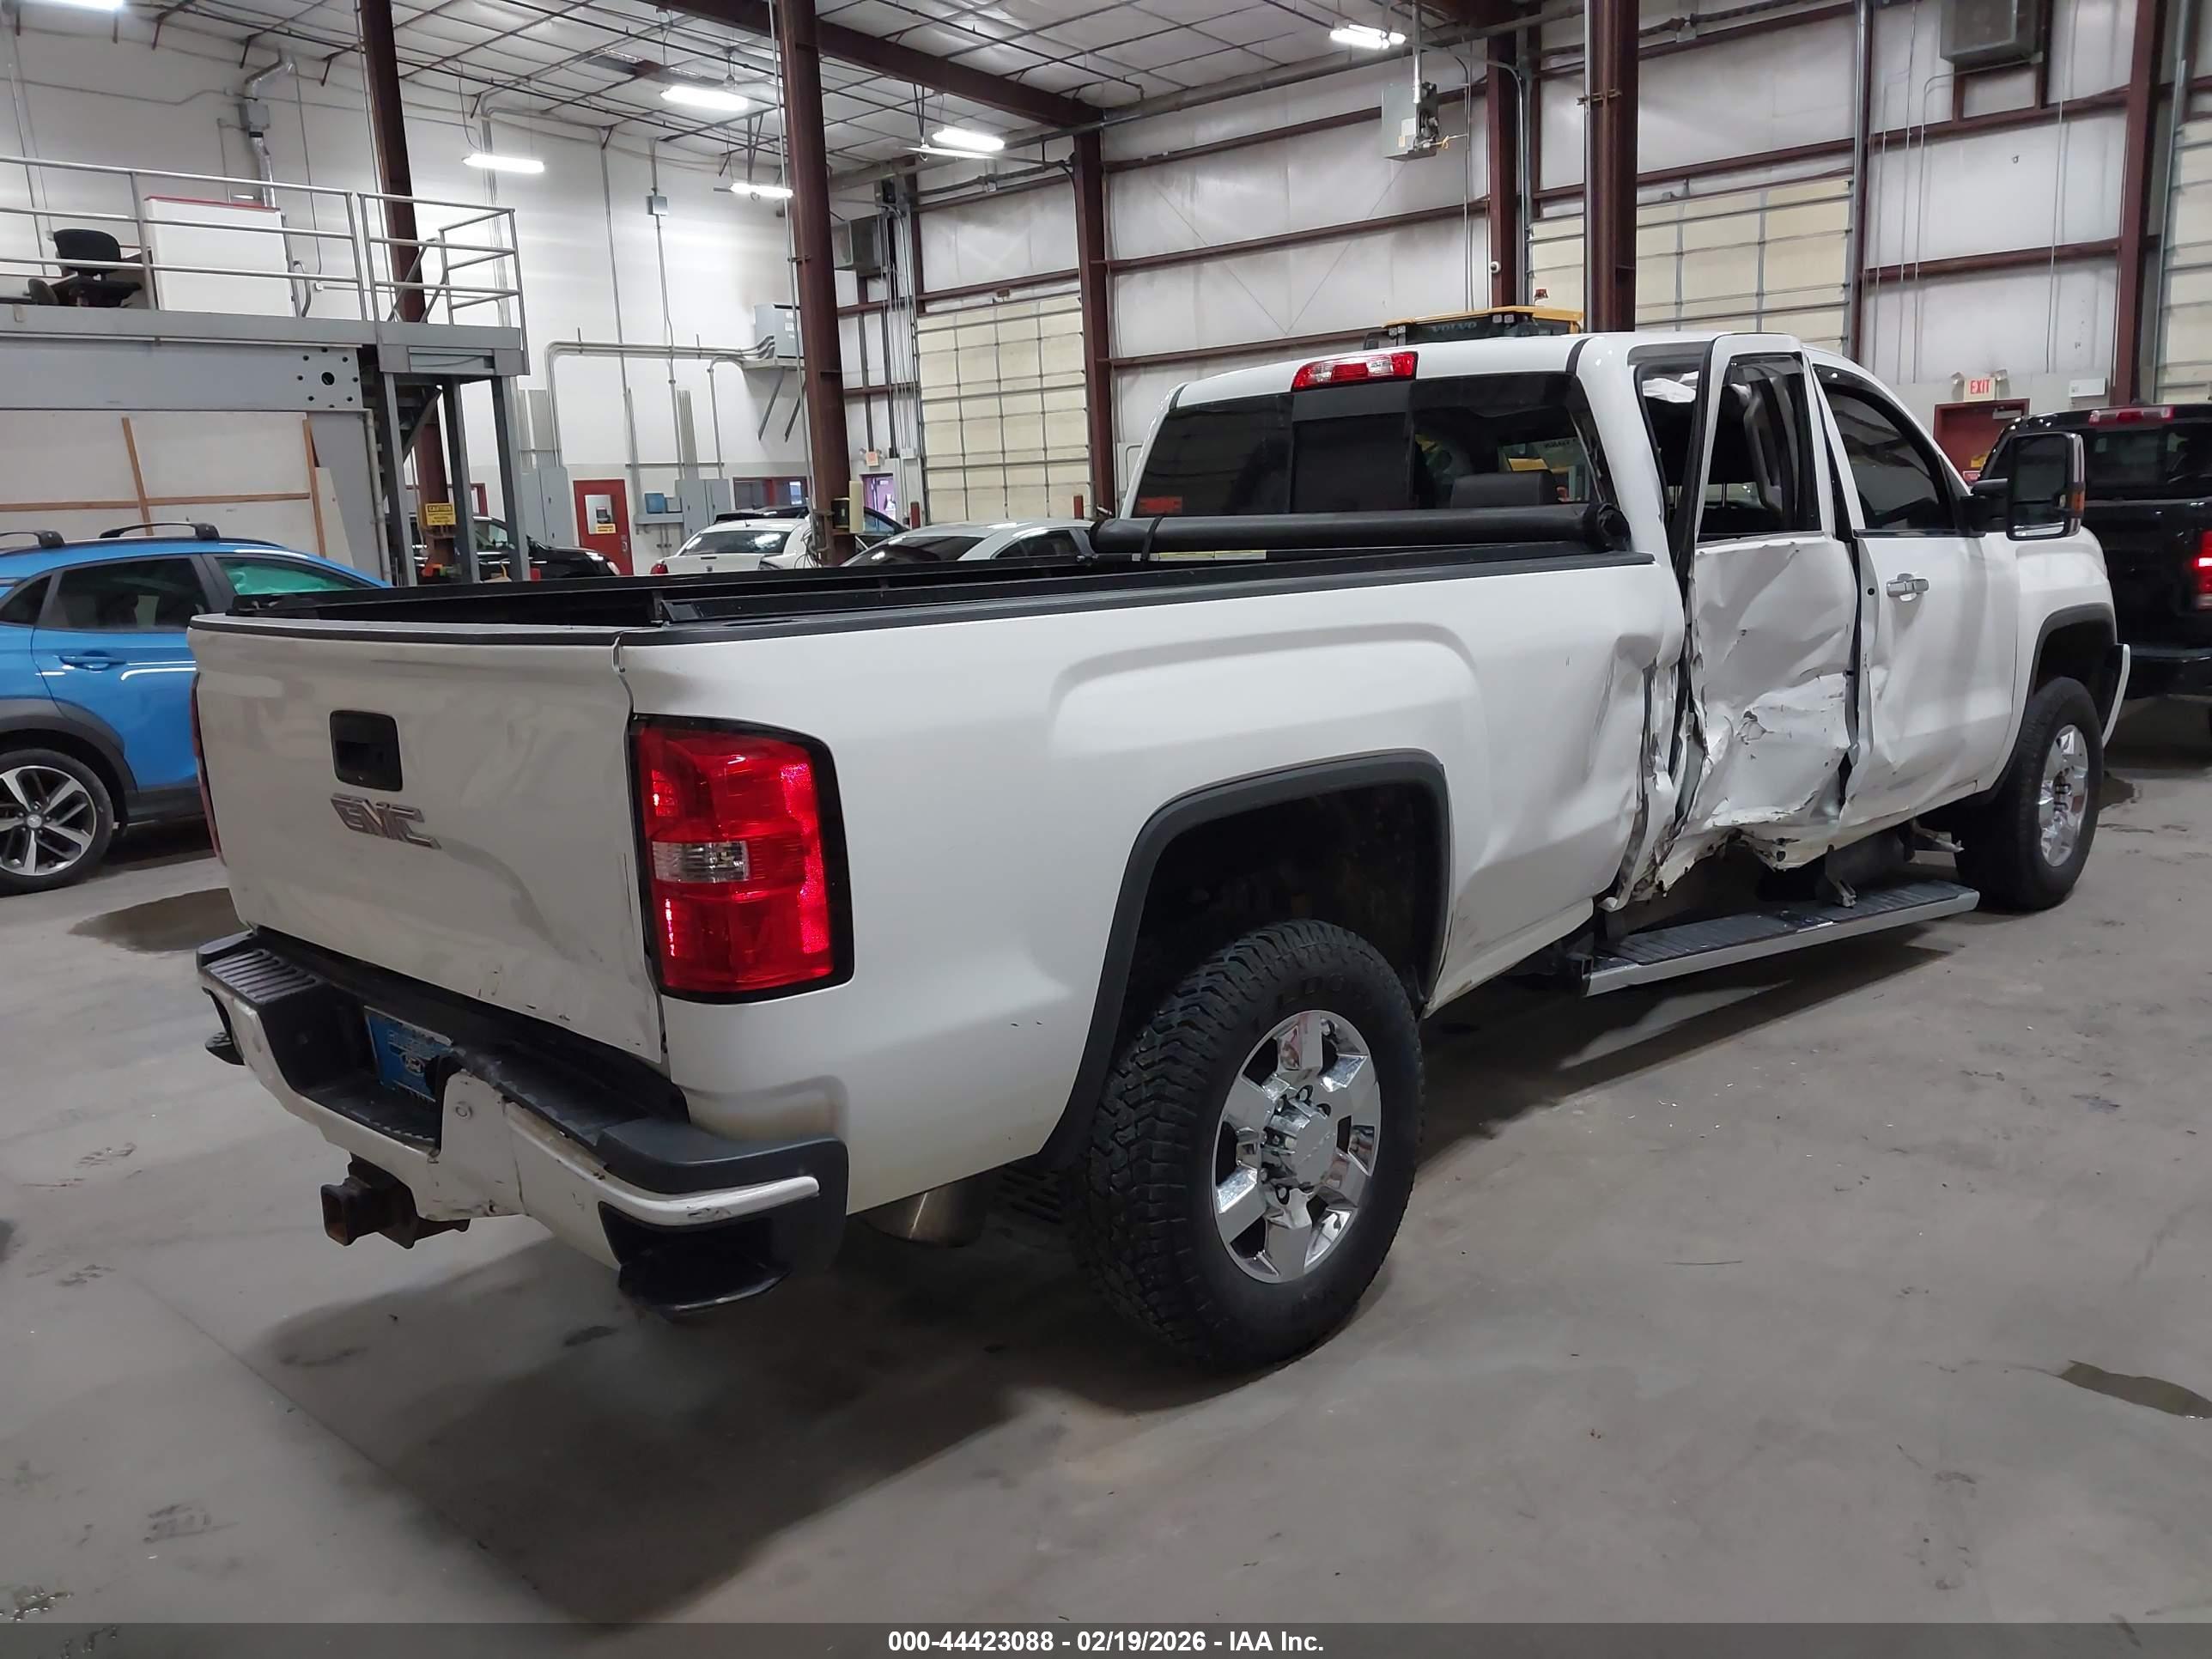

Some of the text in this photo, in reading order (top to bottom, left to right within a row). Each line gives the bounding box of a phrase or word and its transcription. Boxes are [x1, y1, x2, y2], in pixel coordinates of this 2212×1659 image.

[1431, 321, 1477, 333] VOLVO
[1971, 380, 1990, 394] EXIT
[331, 793, 441, 849] GMC
